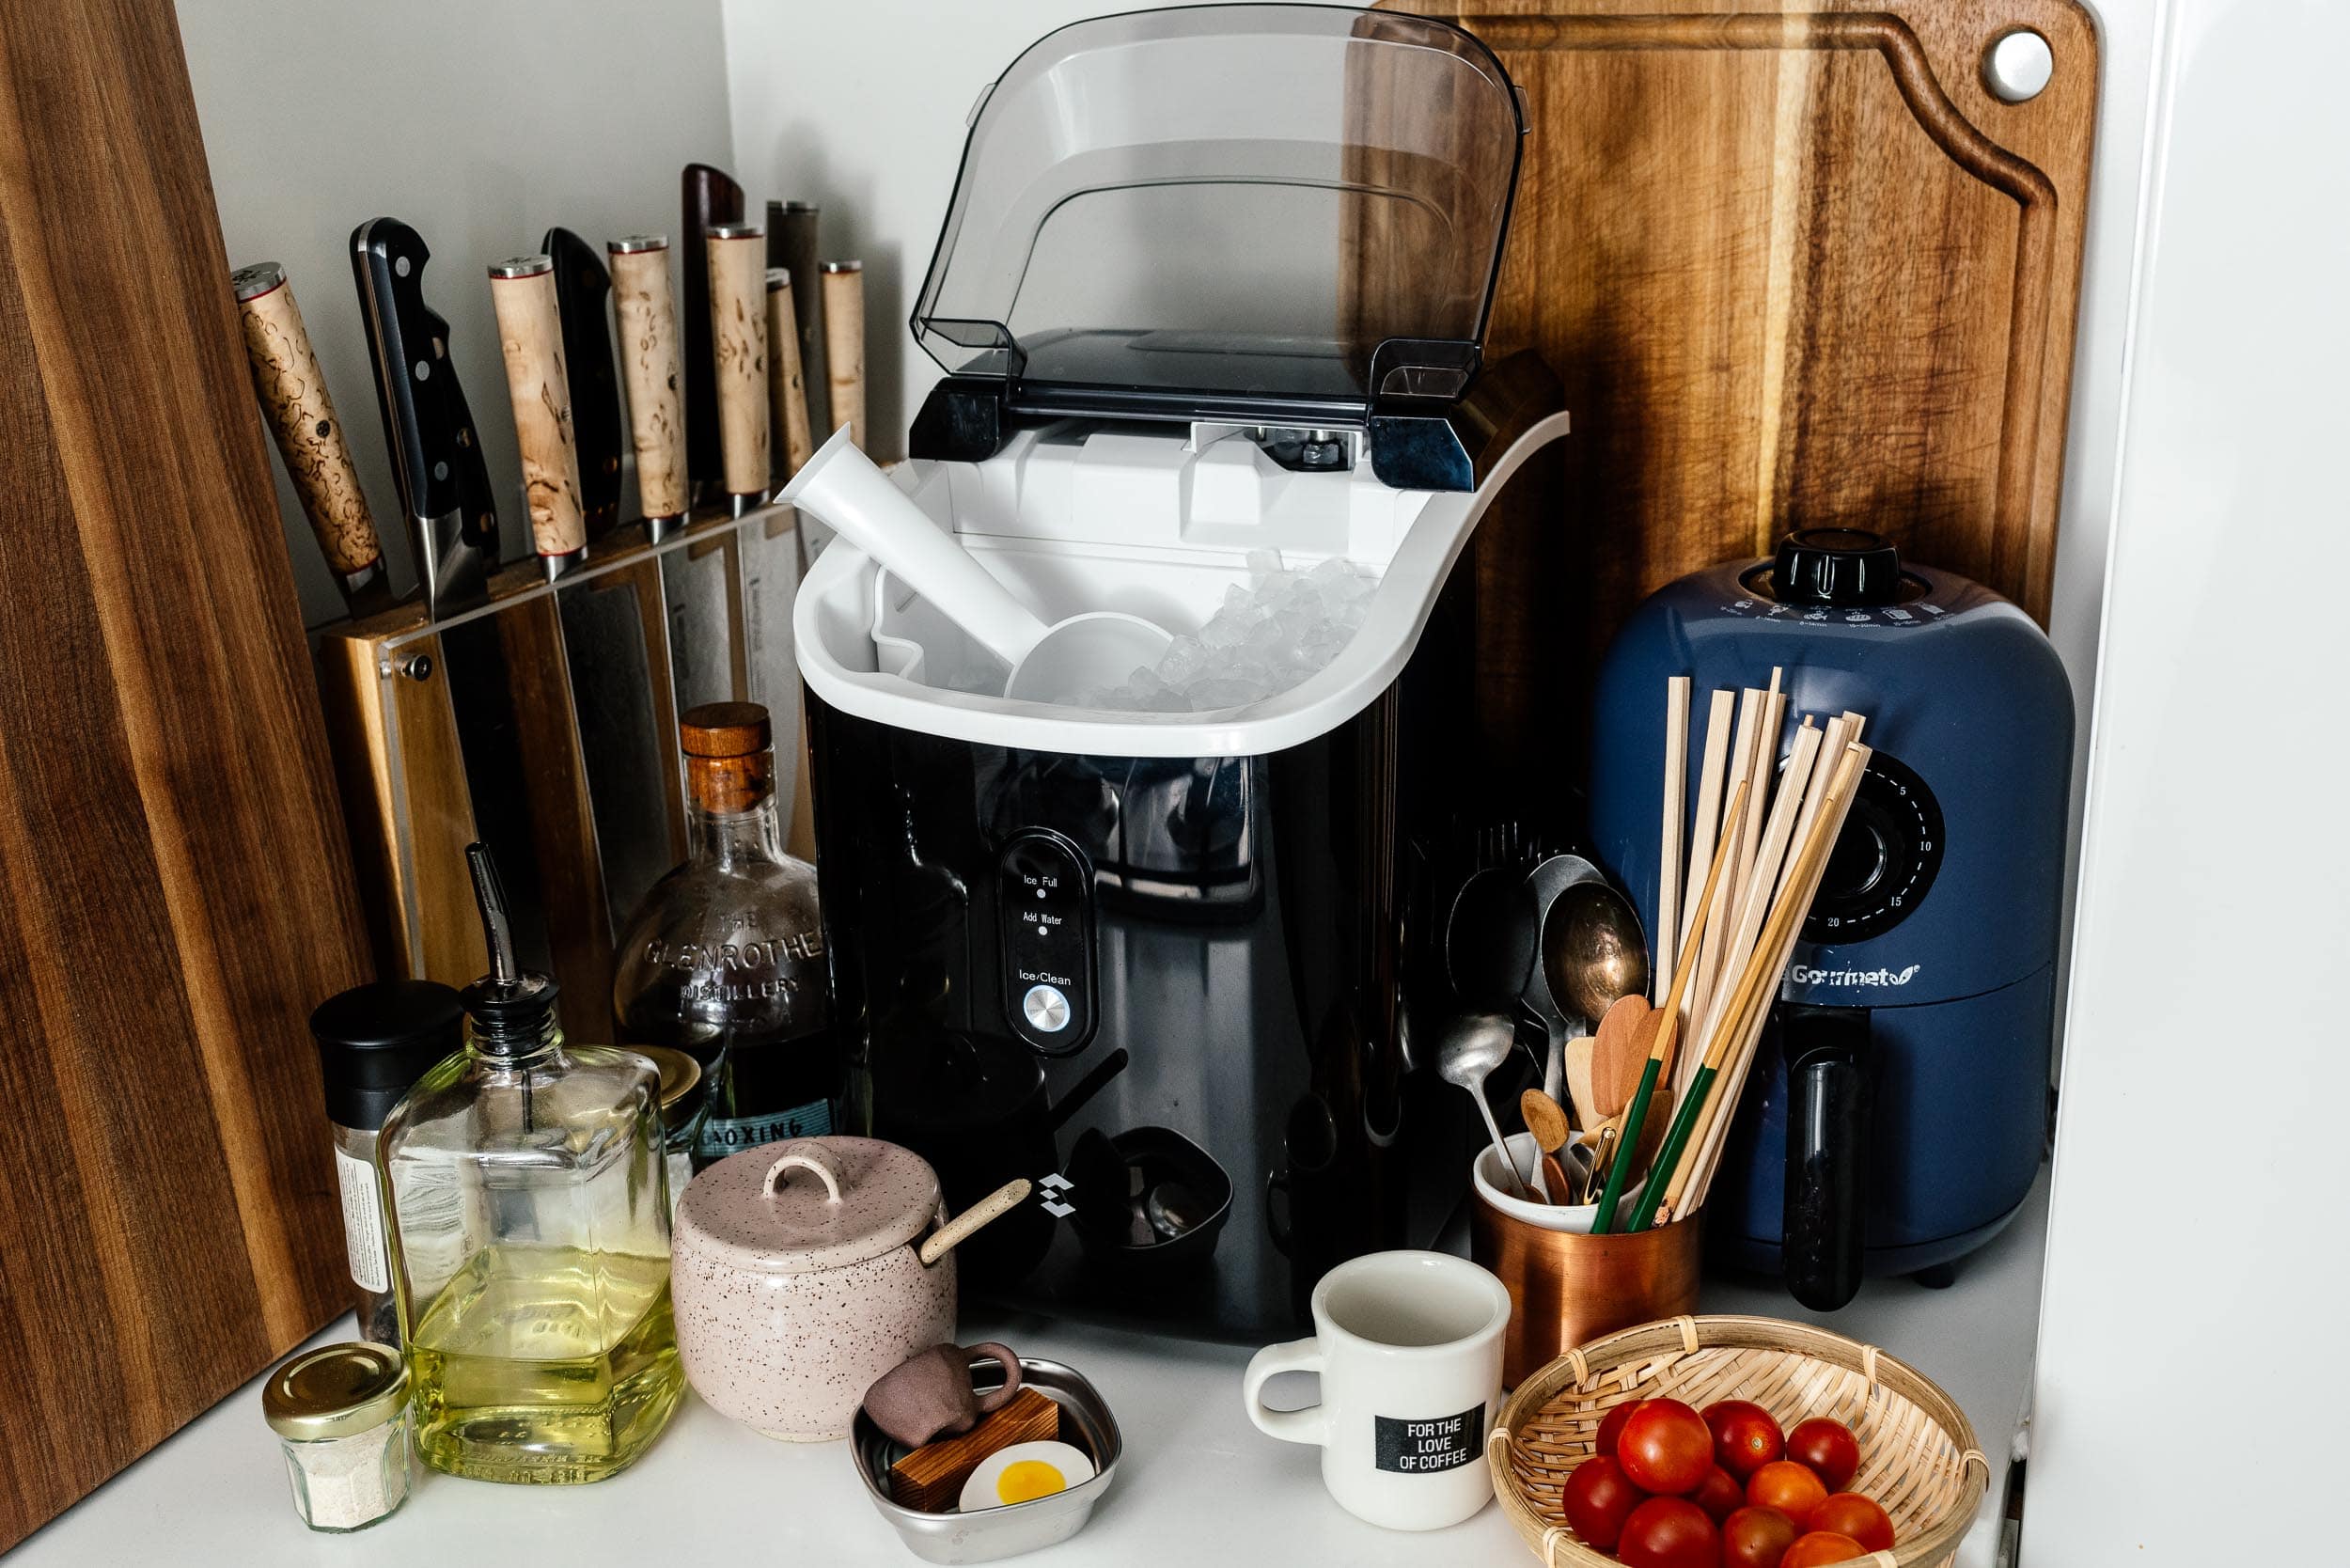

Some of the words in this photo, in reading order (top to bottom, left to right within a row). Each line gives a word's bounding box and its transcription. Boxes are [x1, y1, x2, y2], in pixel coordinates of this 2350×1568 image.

[1900, 786, 1906, 796] 5
[1920, 841, 1932, 852] 10
[1024, 874, 1037, 886] Ice
[1042, 876, 1058, 888] Full
[1890, 896, 1902, 907] 15
[1023, 911, 1037, 922] Add
[1042, 914, 1062, 925] Water
[1827, 917, 1840, 927] 20
[680, 976, 801, 1001] DISTILLERY
[1407, 1423, 1434, 1437] FOR
[1436, 1418, 1462, 1435] THE
[1418, 1436, 1451, 1453] LOVE
[1399, 1455, 1417, 1469] OF
[1419, 1448, 1467, 1469] COFFEE
